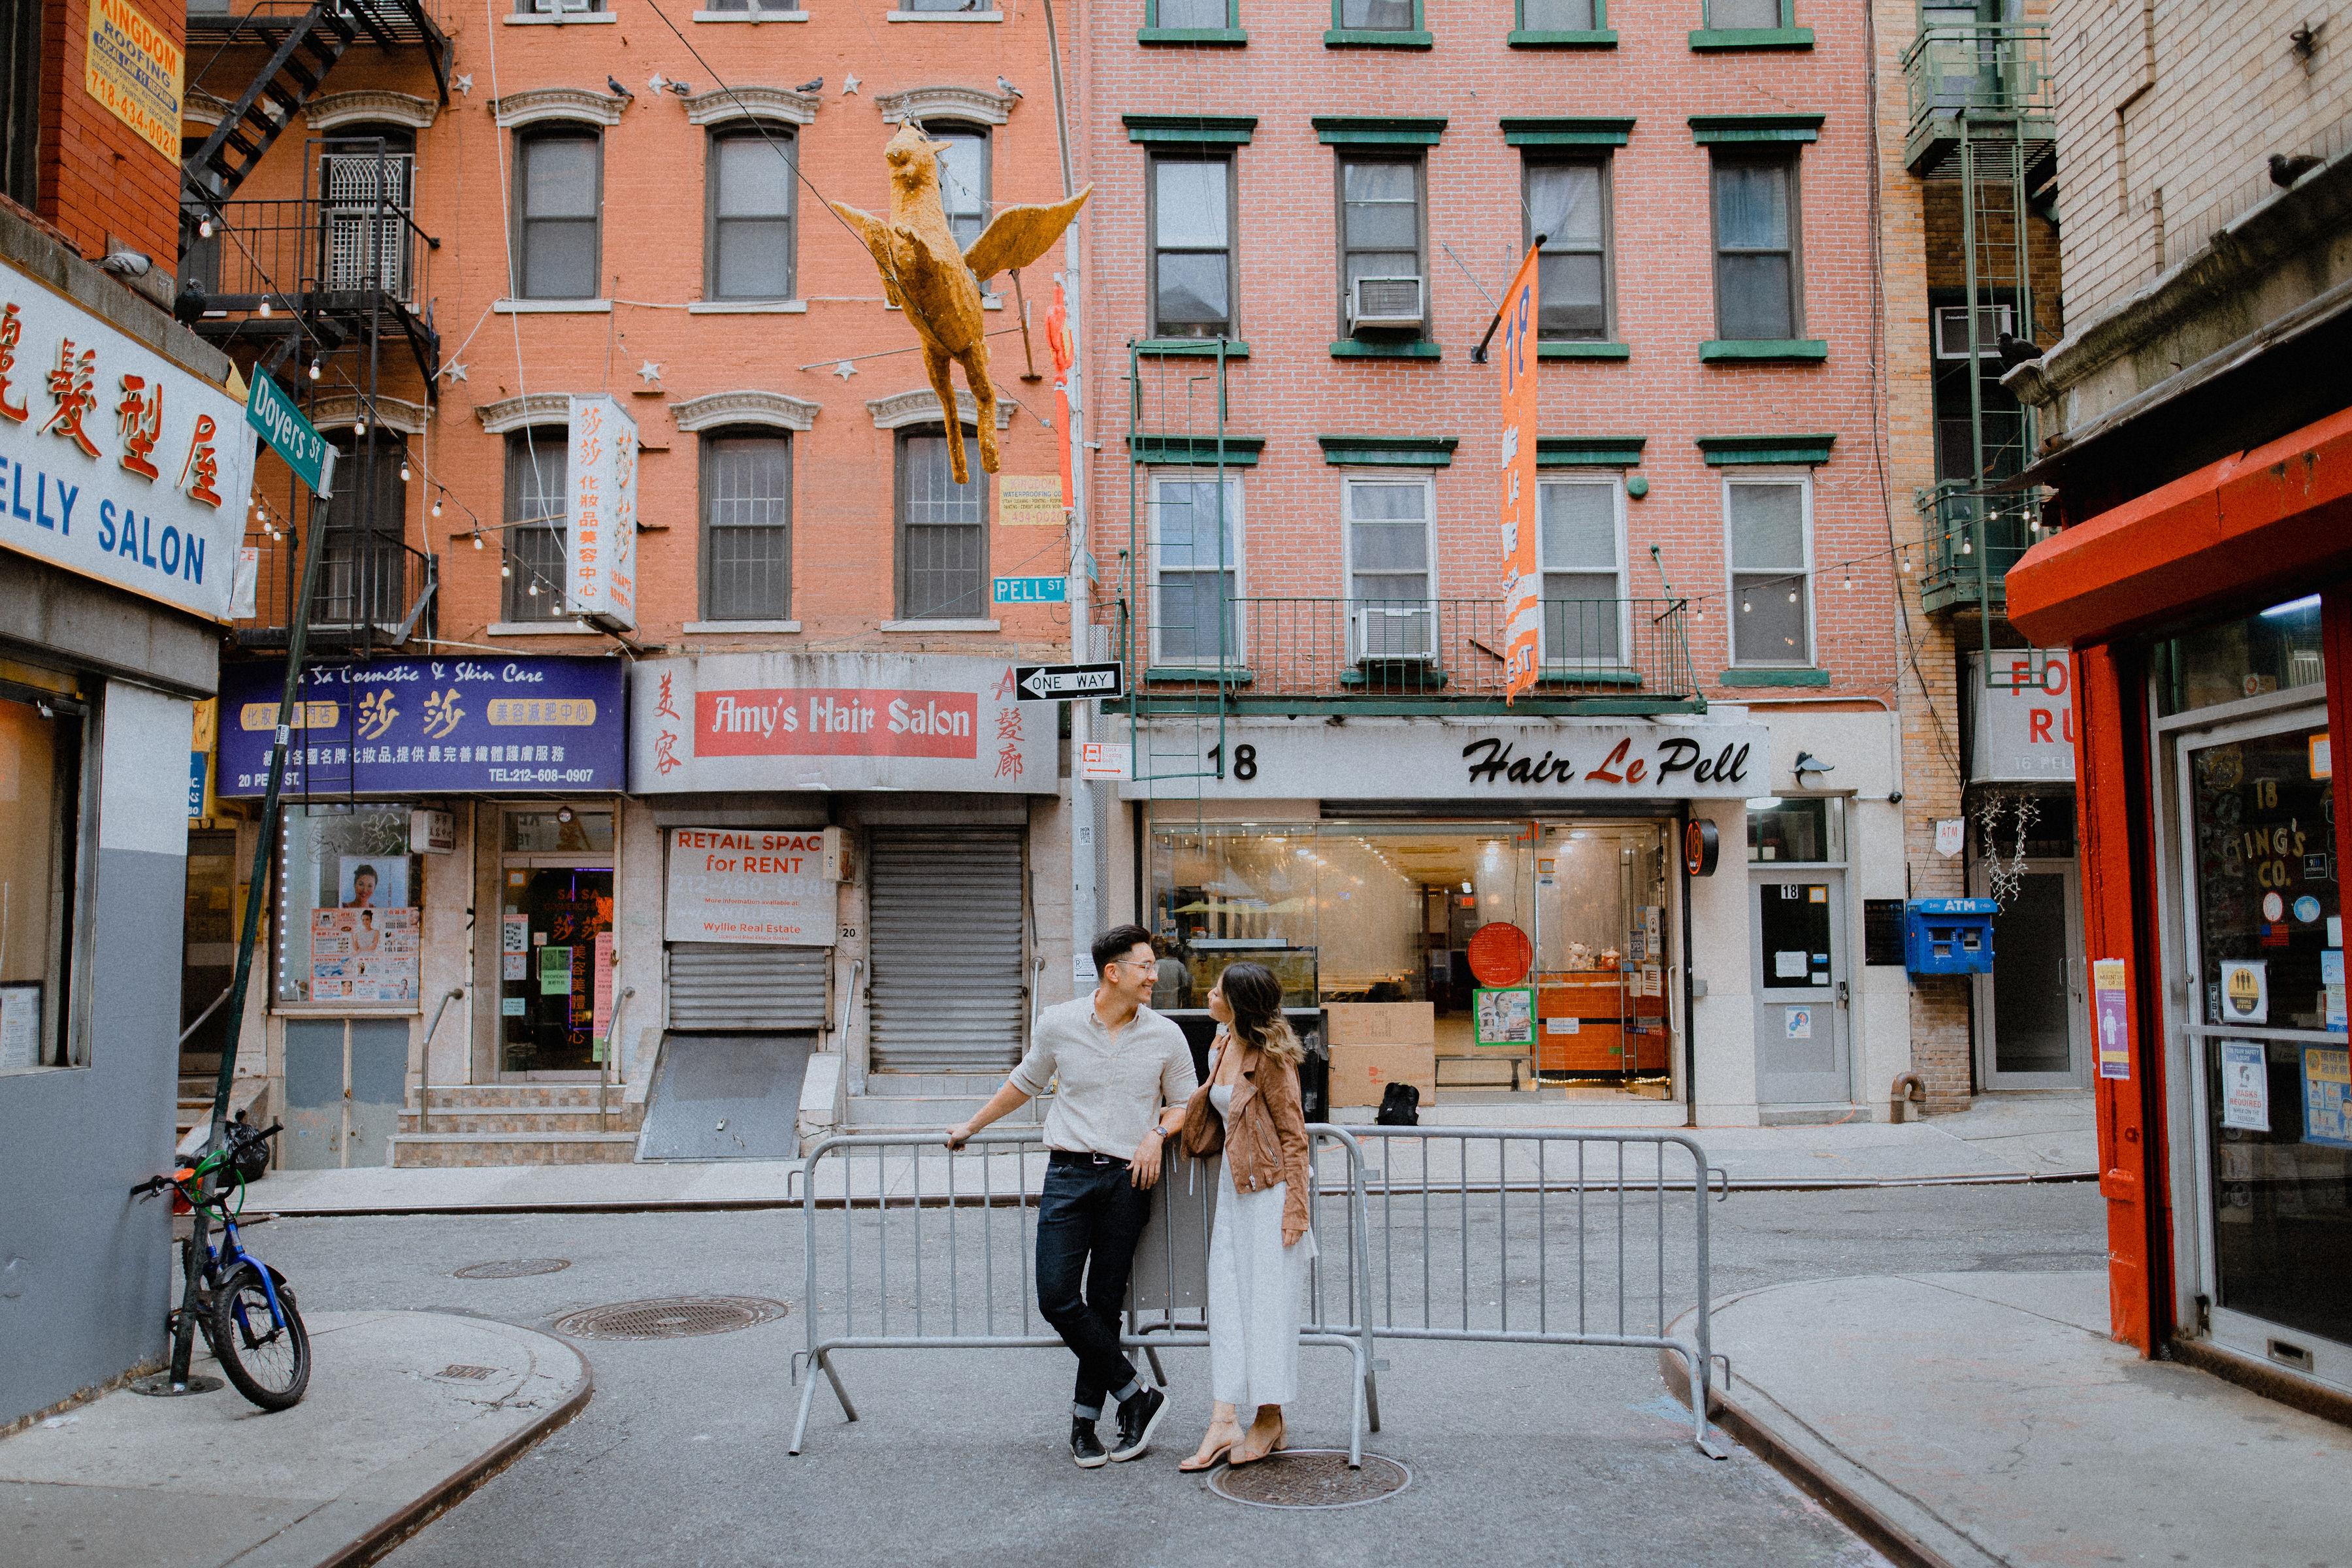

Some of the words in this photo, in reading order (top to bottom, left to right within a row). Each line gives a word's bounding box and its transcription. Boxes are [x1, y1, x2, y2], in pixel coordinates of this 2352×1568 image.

[100, 0, 176, 77] KINGDOM
[105, 19, 171, 88] ROOFING
[97, 35, 120, 63] LOCAL
[122, 53, 138, 76] LAW
[148, 76, 174, 110] REPAIRS
[92, 59, 118, 86] SIDEWALK
[122, 84, 145, 108] PAINTING
[148, 106, 163, 123] BRICK
[164, 118, 176, 135] WORK
[93, 48, 112, 70] STUCCO
[116, 68, 139, 92] POINTING
[142, 88, 177, 125] WATERPROOFING
[91, 69, 177, 157] 718-434-0020
[255, 375, 306, 460] Doyers
[309, 435, 321, 463] St
[99, 498, 205, 585] SALON
[998, 581, 1046, 600] PELL
[1047, 580, 1062, 591] ST
[310, 665, 333, 685] Sa
[341, 664, 419, 684] Cosmetic
[431, 662, 445, 680] &
[454, 662, 495, 682] Skin
[502, 662, 544, 683] Care
[1032, 677, 1062, 690] ONE
[1077, 674, 1107, 687] WAY
[496, 702, 588, 723] 美容減肥中心
[653, 669, 682, 776] 美容
[712, 696, 799, 738] Amy's
[809, 696, 875, 734] Hair
[887, 697, 970, 737] Salon
[1207, 743, 1258, 780] 18
[1462, 737, 1575, 783] Hair
[1584, 736, 1648, 783] Le
[1656, 737, 1750, 785] Pell
[238, 774, 251, 787] 20
[284, 772, 299, 786] ST.
[489, 768, 594, 783] TEL:212-608-0907
[2257, 781, 2278, 809] 18
[678, 832, 755, 850] RETAIL
[762, 835, 823, 852] SPAC
[1942, 826, 1958, 838] ATM
[706, 854, 736, 872] for
[743, 857, 804, 874] RENT
[2259, 860, 2291, 888] CO.
[558, 889, 574, 900] SA
[581, 889, 599, 900] SA
[1783, 885, 1797, 898] 18
[1944, 900, 1976, 911] ATM
[703, 922, 737, 933] Wyllie
[740, 923, 764, 932] Real
[766, 924, 801, 934] Estate
[843, 928, 856, 938] 20
[1630, 941, 1644, 951] OPEN
[568, 945, 586, 1045] 美容美體中心
[2229, 1098, 2262, 1109] REQUIRED
[2236, 1089, 2258, 1098] MASKS
